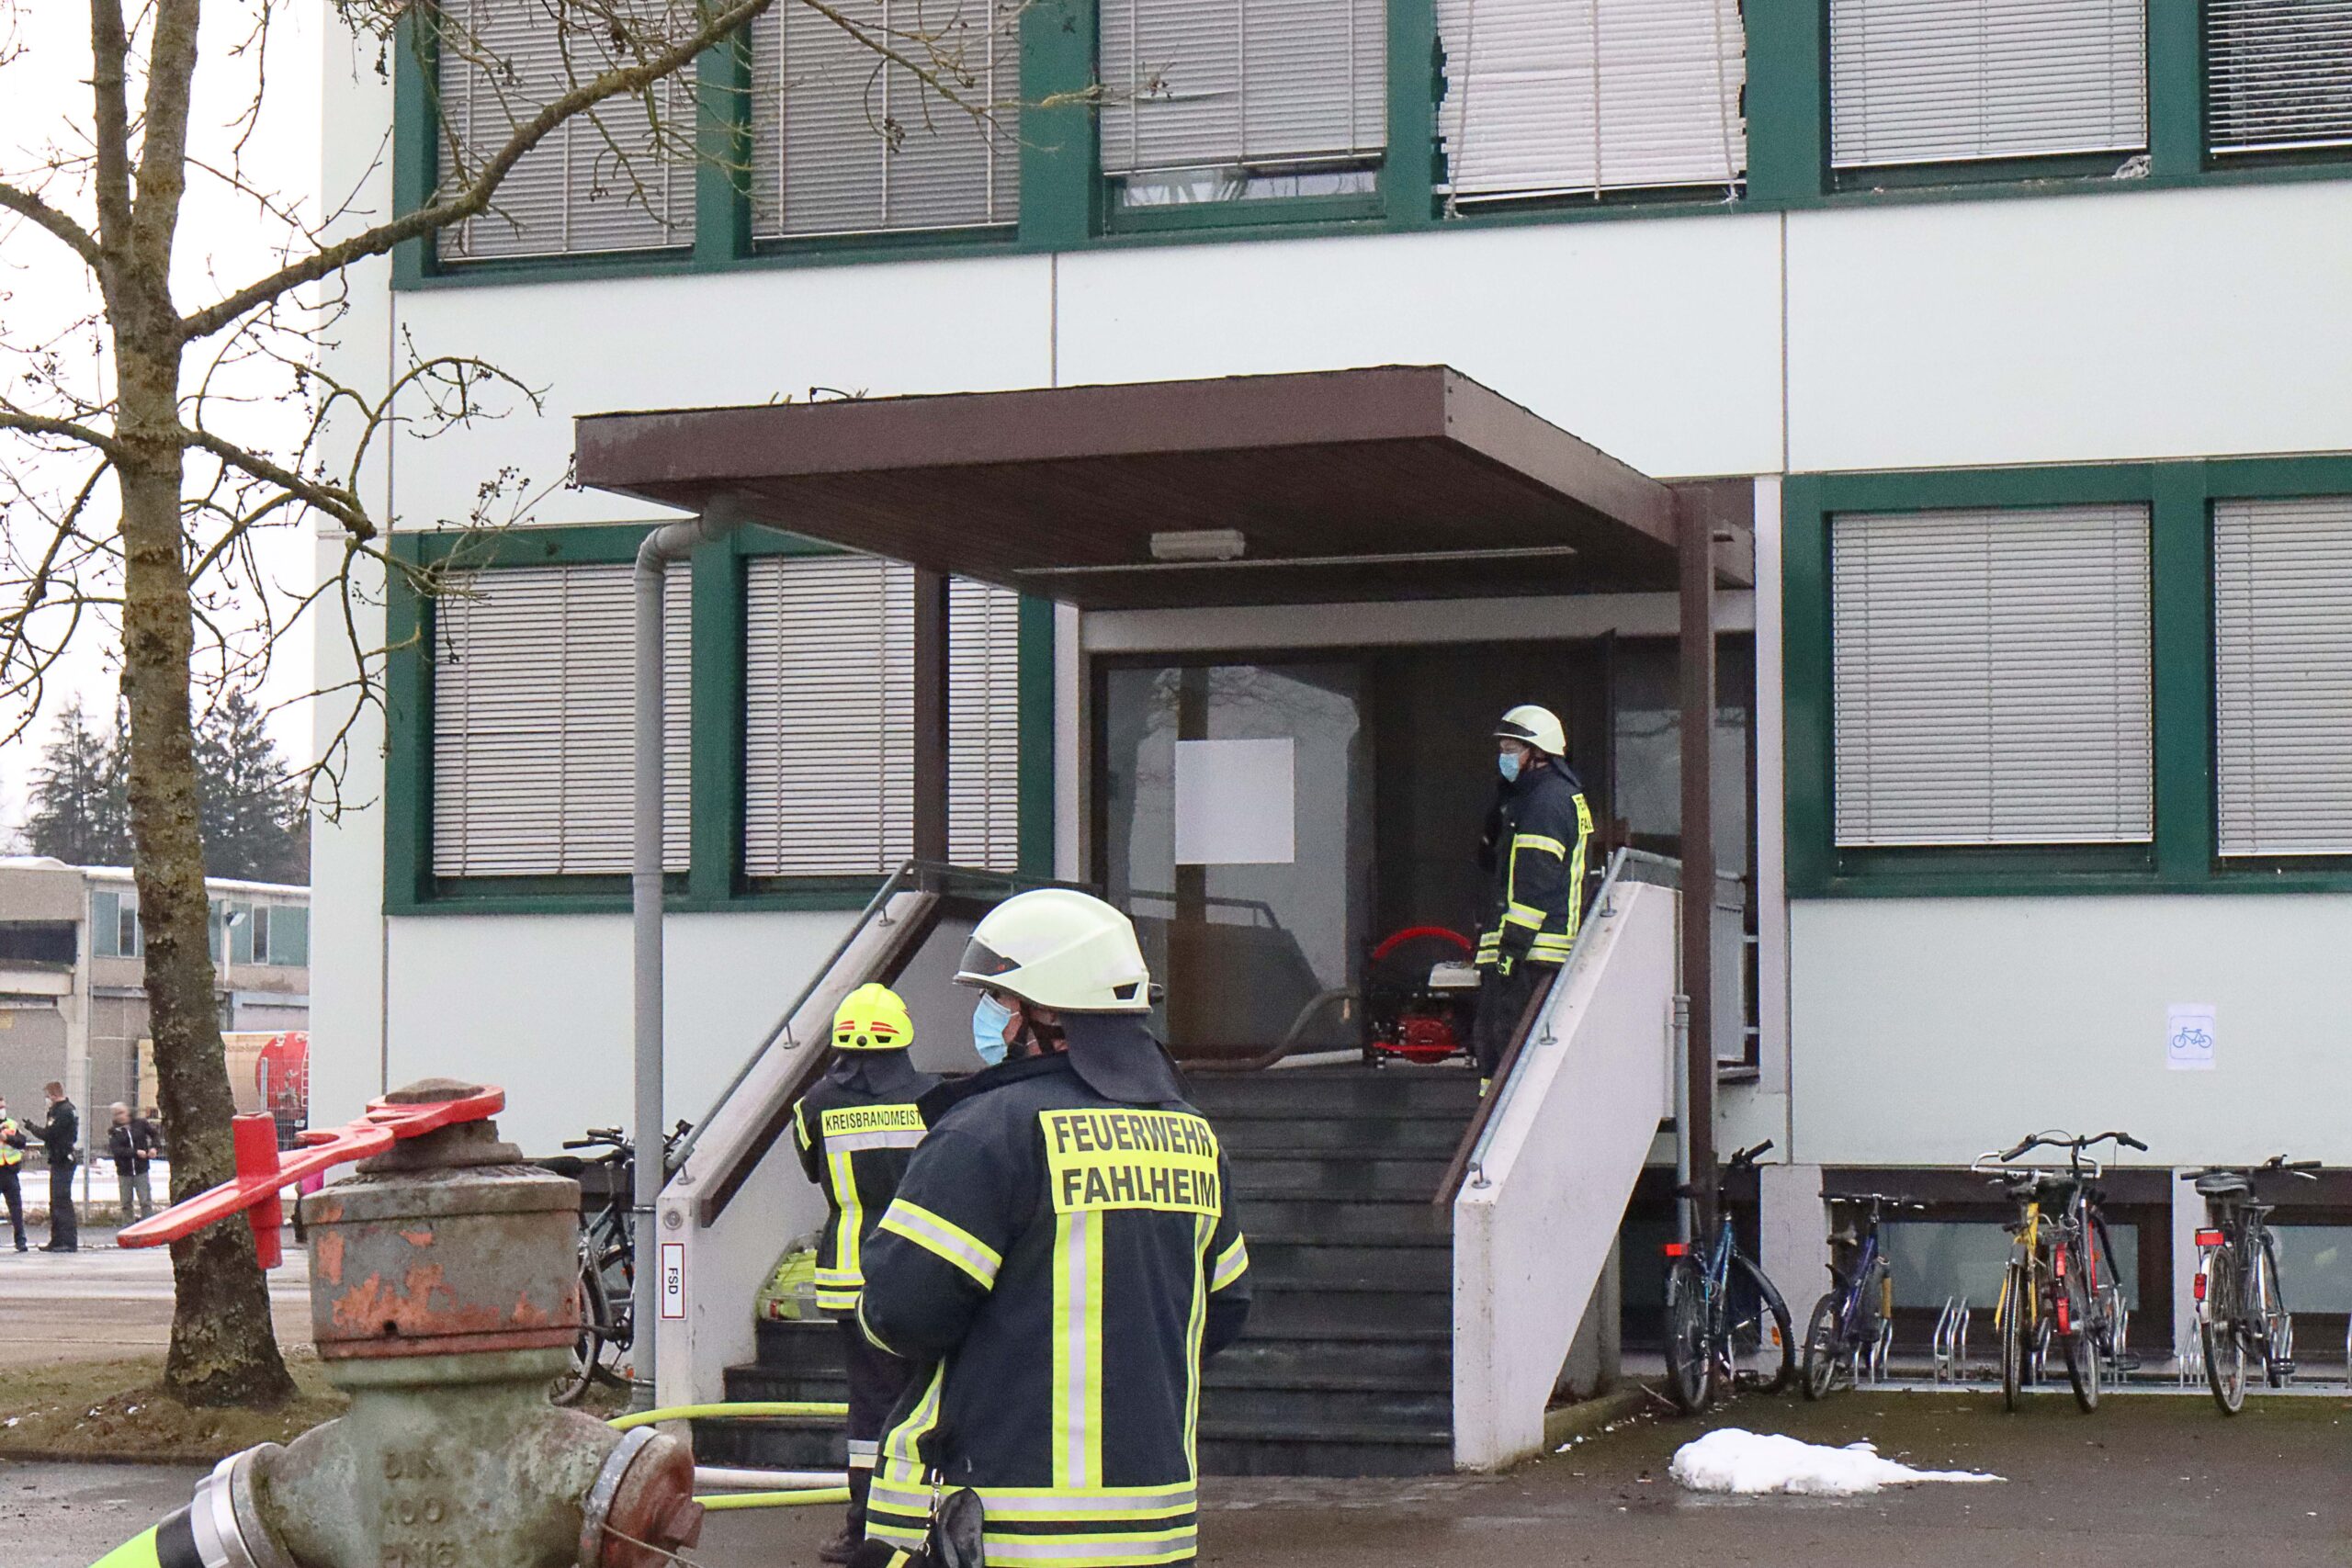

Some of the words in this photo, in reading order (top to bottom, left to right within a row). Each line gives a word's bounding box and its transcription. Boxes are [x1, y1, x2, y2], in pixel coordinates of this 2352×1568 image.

[1052, 1114, 1213, 1158] FEUERWEHR
[1062, 1166, 1216, 1209] FAHLHEIM
[668, 1267, 679, 1295] FSD
